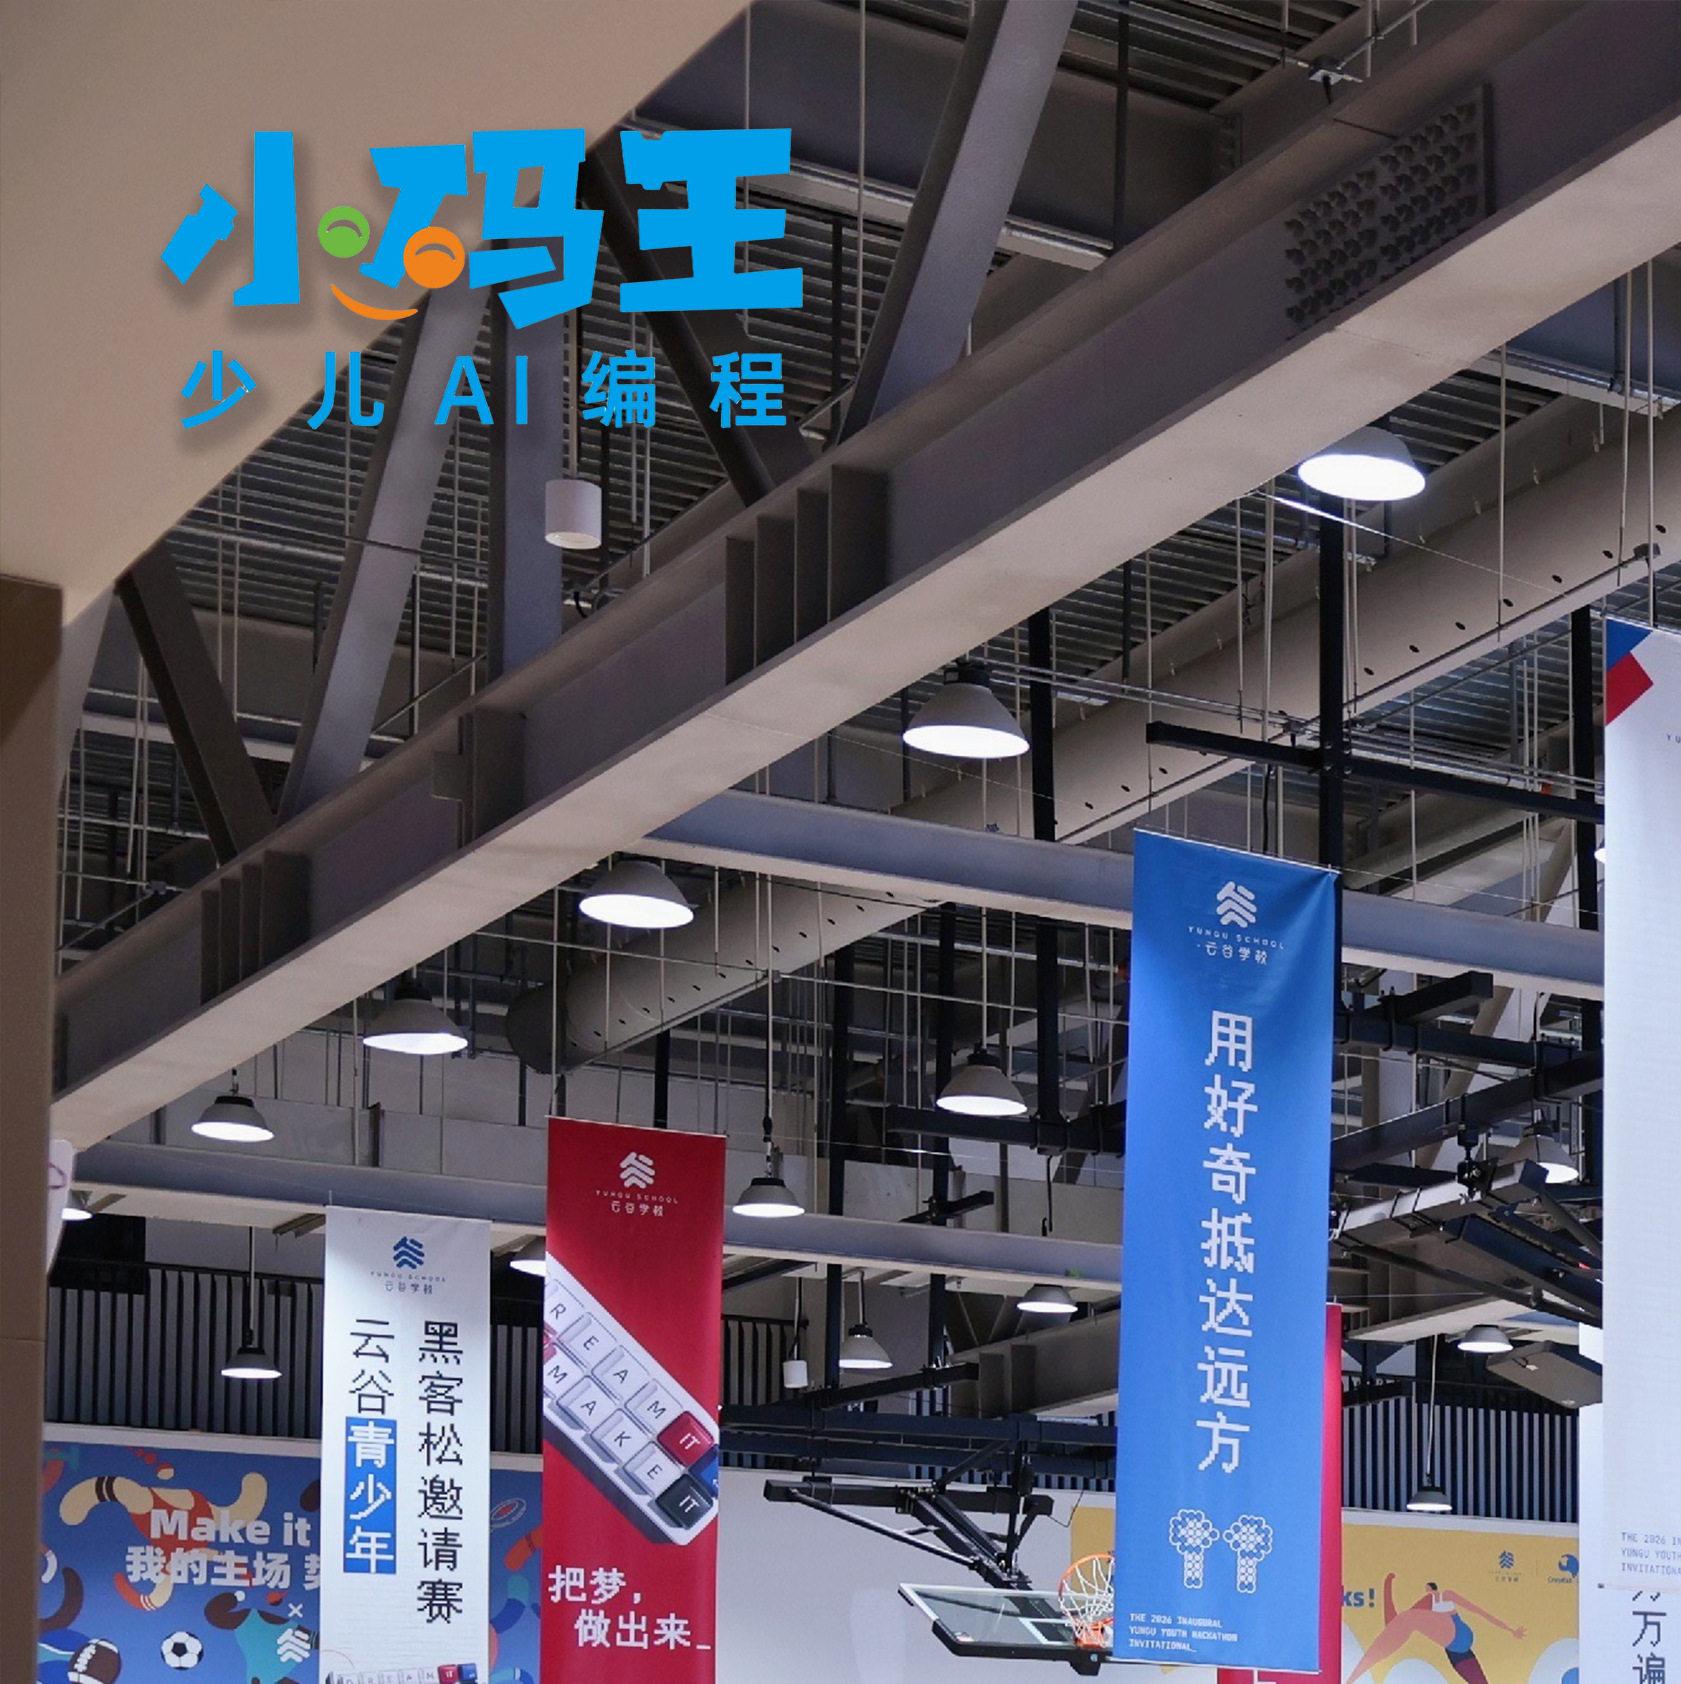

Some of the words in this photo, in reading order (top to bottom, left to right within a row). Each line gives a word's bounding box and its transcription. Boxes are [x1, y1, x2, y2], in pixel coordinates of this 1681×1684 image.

[1189, 925, 1228, 940] YUNGU
[1236, 933, 1284, 950] SCHOOL
[1204, 942, 1267, 965] 云谷学校
[1197, 1010, 1258, 1474] 用好奇抵达远方
[345, 1318, 396, 1573] 云谷青少年
[417, 1320, 463, 1624] 黑客松邀请赛
[150, 1510, 270, 1547] Make
[283, 1513, 312, 1546] it
[1621, 1532, 1639, 1543] THE
[1644, 1533, 1667, 1545] 2026
[1621, 1548, 1650, 1560] YUNGU
[125, 1546, 292, 1590] 我的主场
[1130, 1613, 1146, 1623] THE
[1151, 1615, 1173, 1625] 2026
[1177, 1616, 1223, 1629] INAUGURAL
[1129, 1626, 1156, 1637] YUNGU
[1160, 1627, 1188, 1638] YOUTH
[1191, 1630, 1238, 1642] HACKATHON
